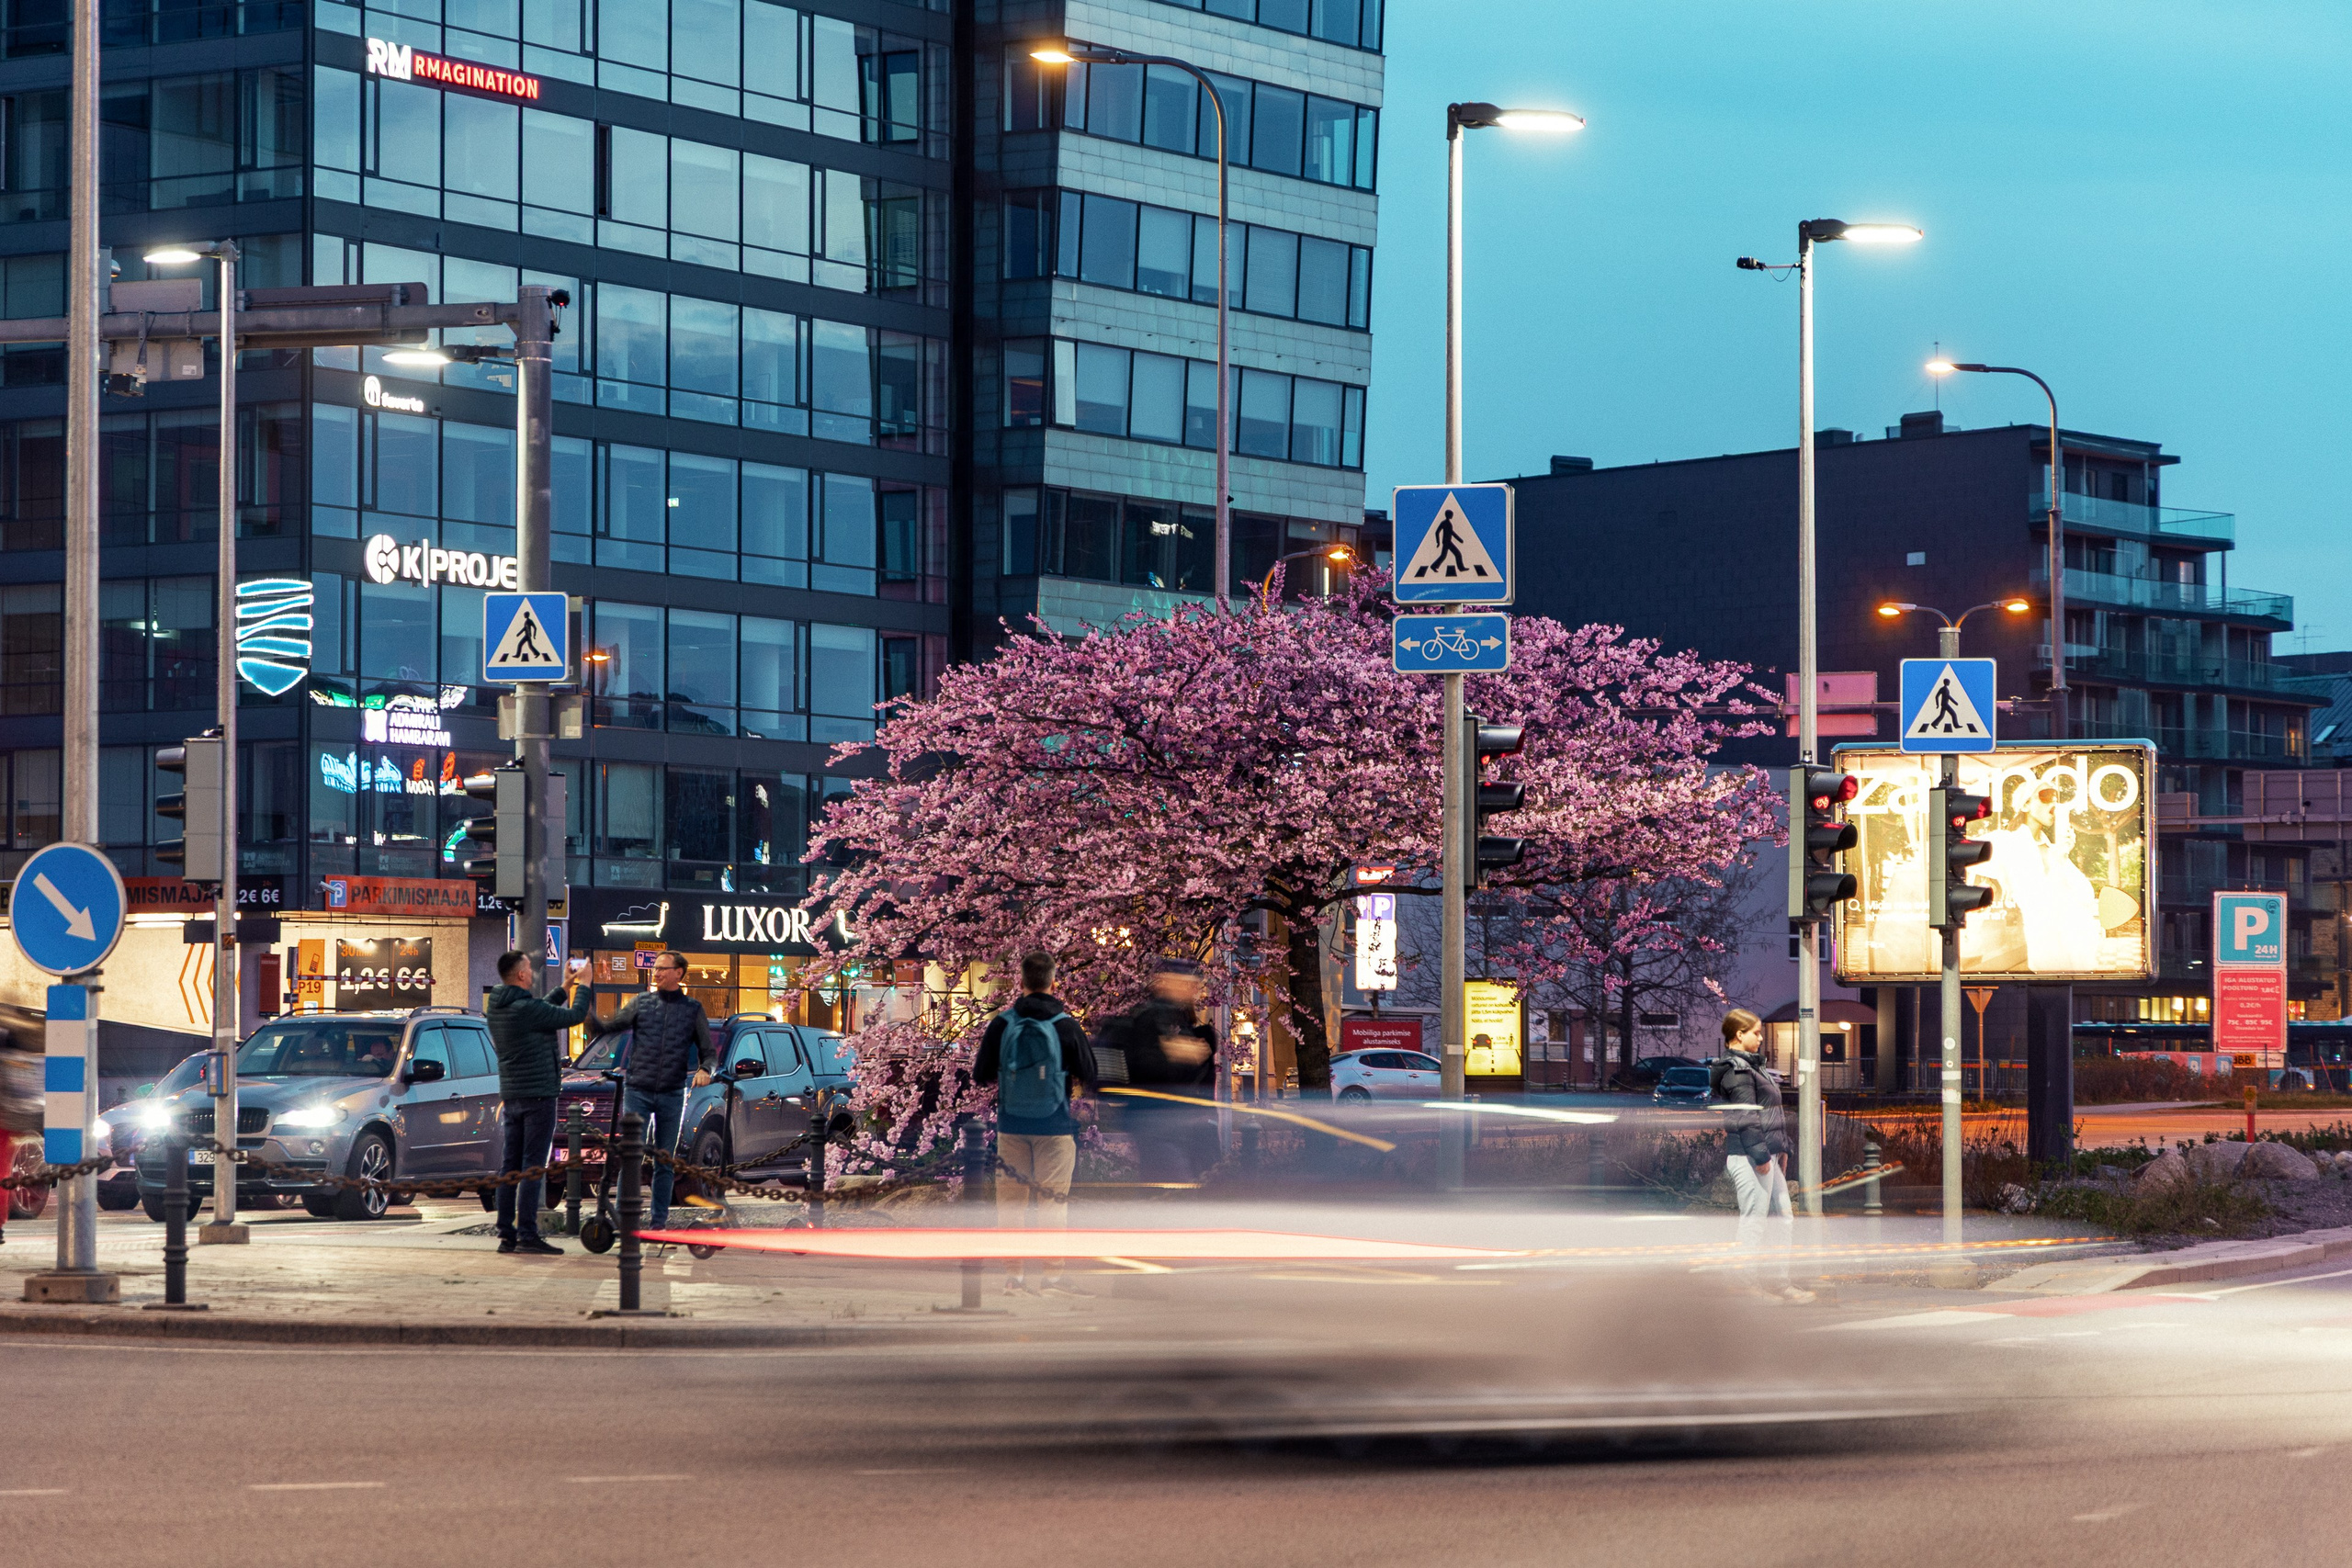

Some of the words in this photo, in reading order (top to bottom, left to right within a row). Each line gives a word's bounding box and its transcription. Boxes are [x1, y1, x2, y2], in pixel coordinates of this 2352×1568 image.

[413, 55, 539, 99] RMAGINATION
[389, 712, 441, 731] ADMIRALI
[389, 728, 451, 747] HAMBARAVI
[1848, 755, 2139, 815] zando
[261, 888, 279, 903] 6€
[350, 886, 471, 908] PARKIMISMAJA
[478, 895, 503, 911] 1,2€
[702, 905, 814, 943] LUXOR
[2234, 906, 2269, 951] P
[400, 943, 419, 956] 24h
[2255, 944, 2278, 954] 24H
[299, 981, 322, 994] P19
[340, 967, 390, 995] 1,2€
[397, 966, 426, 991] 6€
[1352, 1029, 1381, 1038] Mobiiliga
[1382, 1029, 1411, 1038] parkimise
